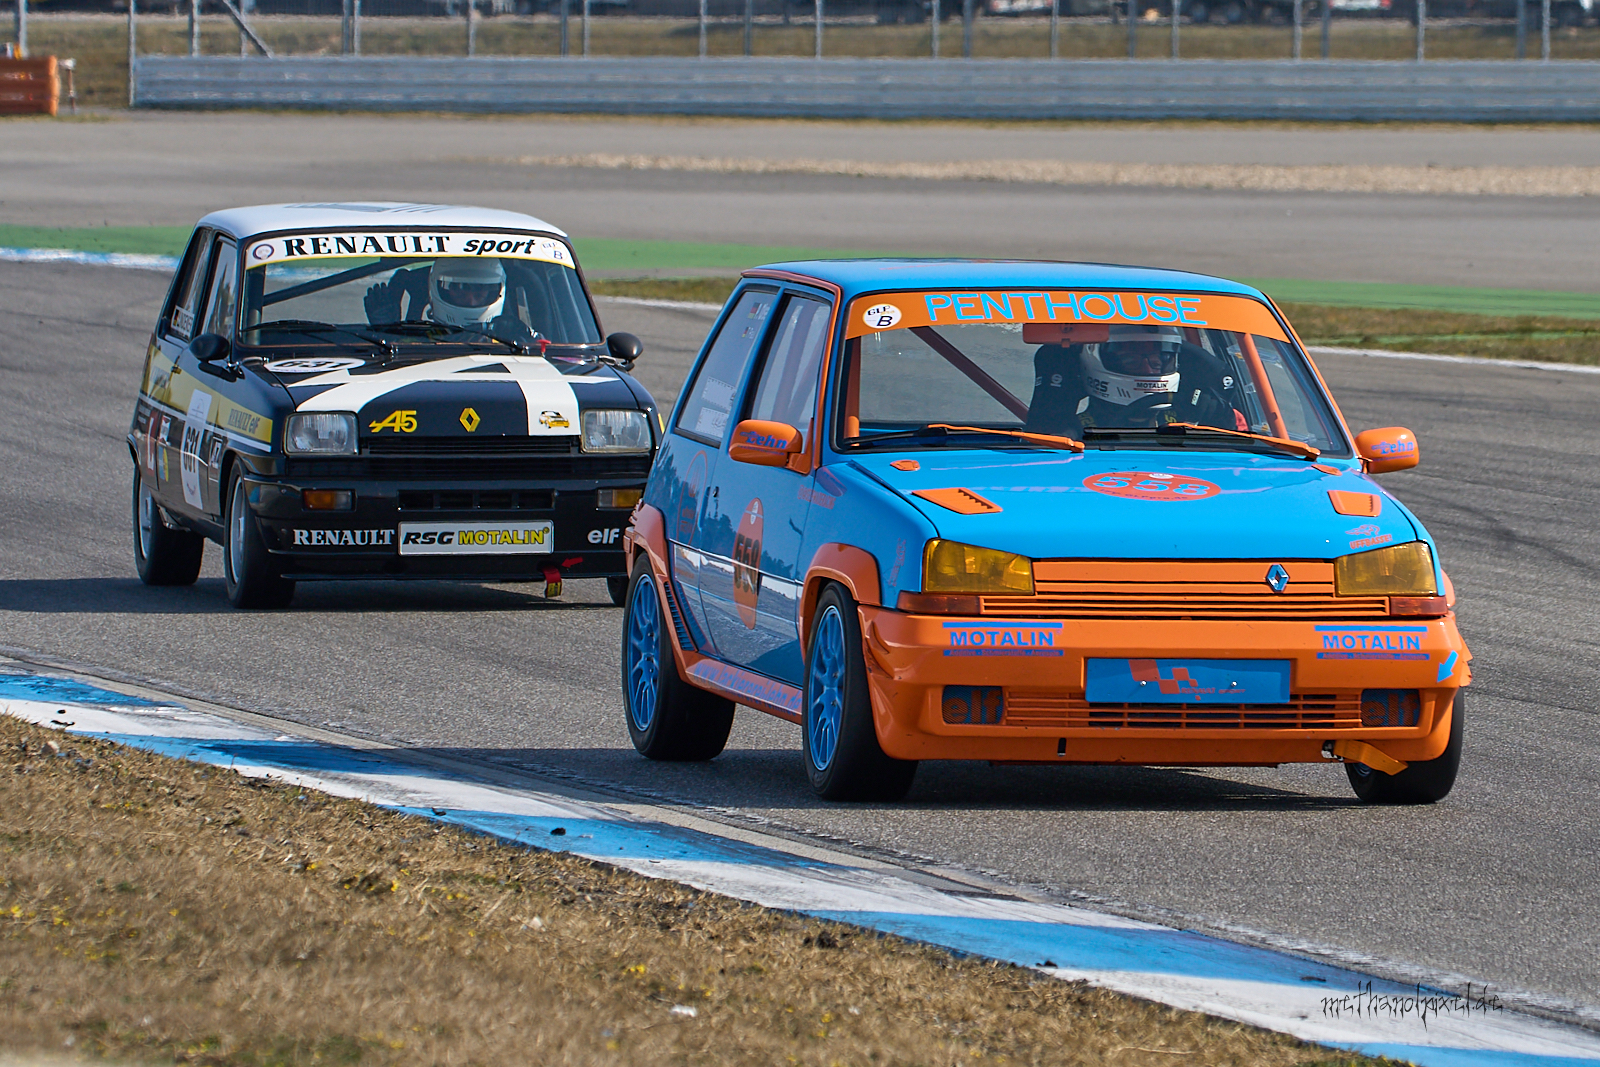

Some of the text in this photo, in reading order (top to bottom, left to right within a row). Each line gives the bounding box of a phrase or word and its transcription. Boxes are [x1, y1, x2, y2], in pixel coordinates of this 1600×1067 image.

[283, 235, 535, 256] RENAULT sport
[867, 305, 891, 316] GLP
[924, 292, 1208, 325] PENTHOUSE
[876, 315, 893, 327] B
[1093, 476, 1211, 496] 558
[292, 529, 395, 546] RENAULT
[403, 530, 545, 545] RSG MOTALIN
[587, 528, 620, 544] elf
[1349, 533, 1393, 550] UFFBASSE!
[950, 631, 1054, 646] MOTALIN
[1322, 634, 1421, 650] MOTALIN
[942, 689, 1001, 724] elf
[1361, 693, 1420, 726] elf
